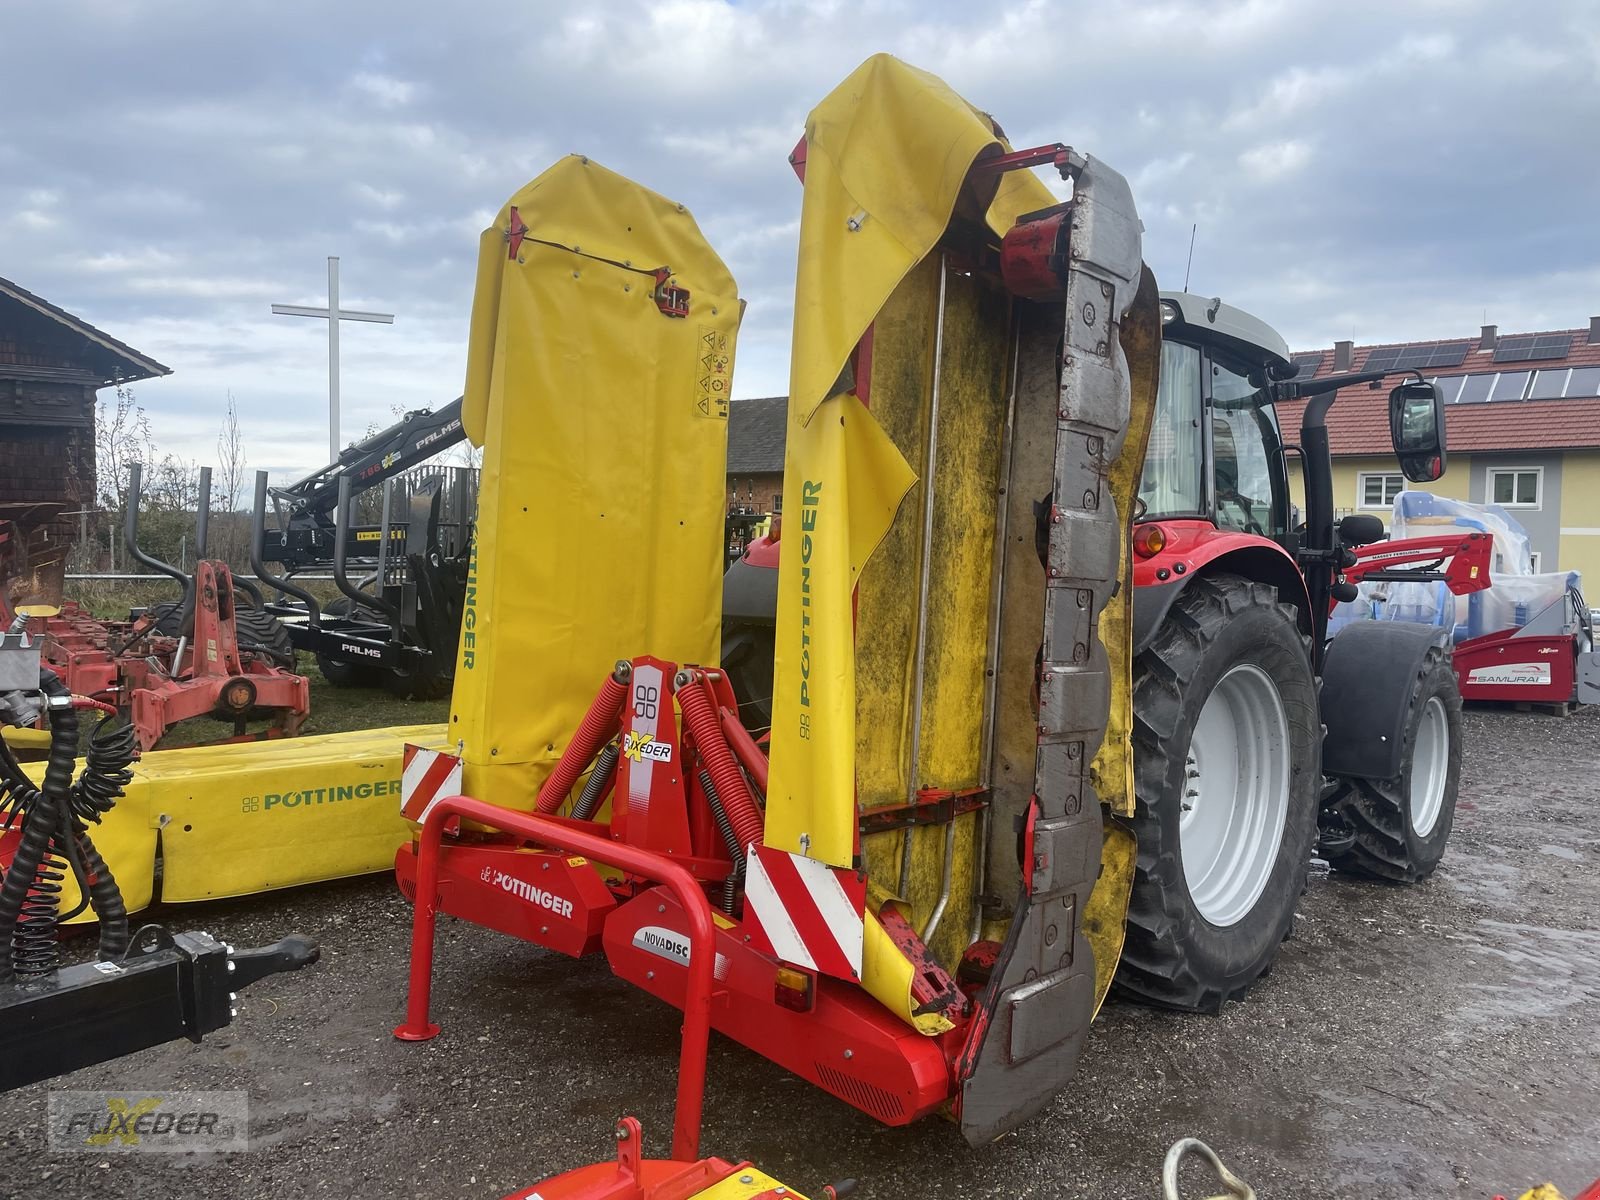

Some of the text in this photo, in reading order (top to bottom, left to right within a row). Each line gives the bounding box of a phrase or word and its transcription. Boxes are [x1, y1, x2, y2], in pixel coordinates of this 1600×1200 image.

[415, 419, 461, 450] PALMS
[800, 480, 823, 707] PÖTTINGER
[341, 643, 381, 658] PALMS
[264, 779, 402, 811] PÖTTINGER
[644, 931, 689, 958] NOVADISC
